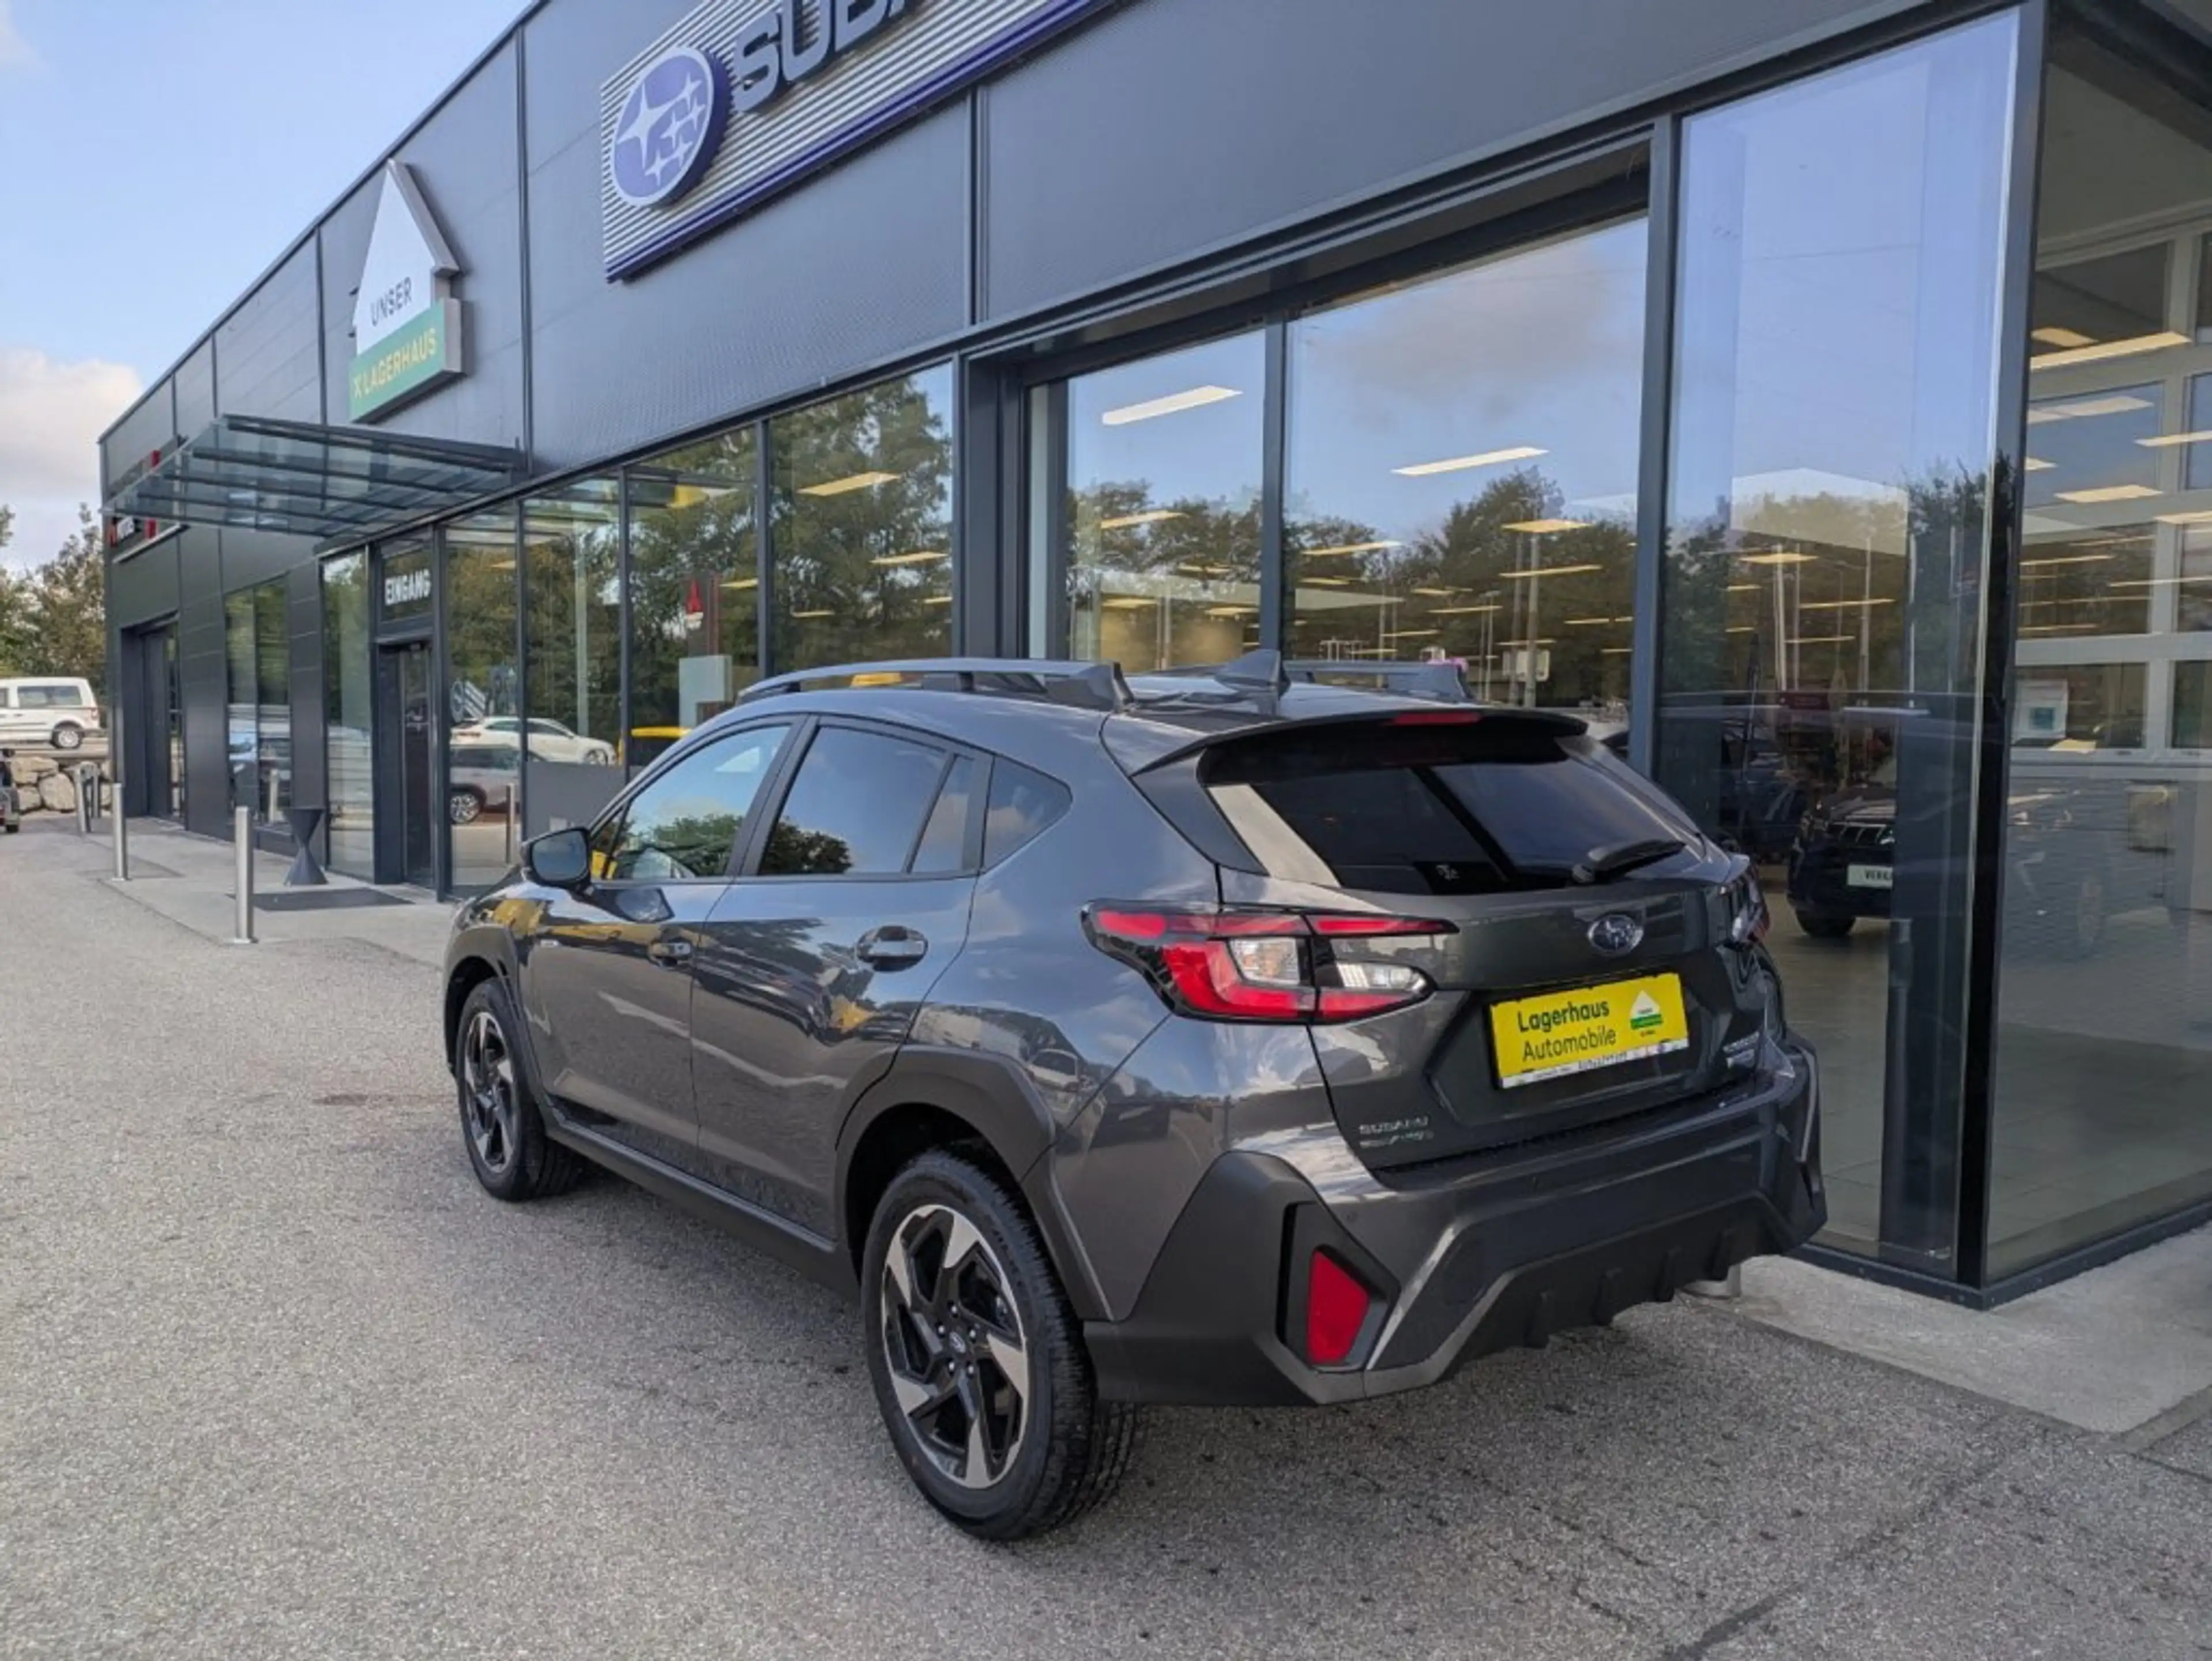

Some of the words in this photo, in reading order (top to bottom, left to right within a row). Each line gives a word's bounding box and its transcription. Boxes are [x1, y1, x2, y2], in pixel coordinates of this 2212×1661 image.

[731, 0, 904, 111] SUB
[370, 277, 412, 327] UNSER
[362, 327, 436, 395] LAGERHAUS
[385, 568, 431, 606] EINGANG
[1518, 1000, 1610, 1032] Lagerhaus
[1522, 1025, 1616, 1062] Automobile
